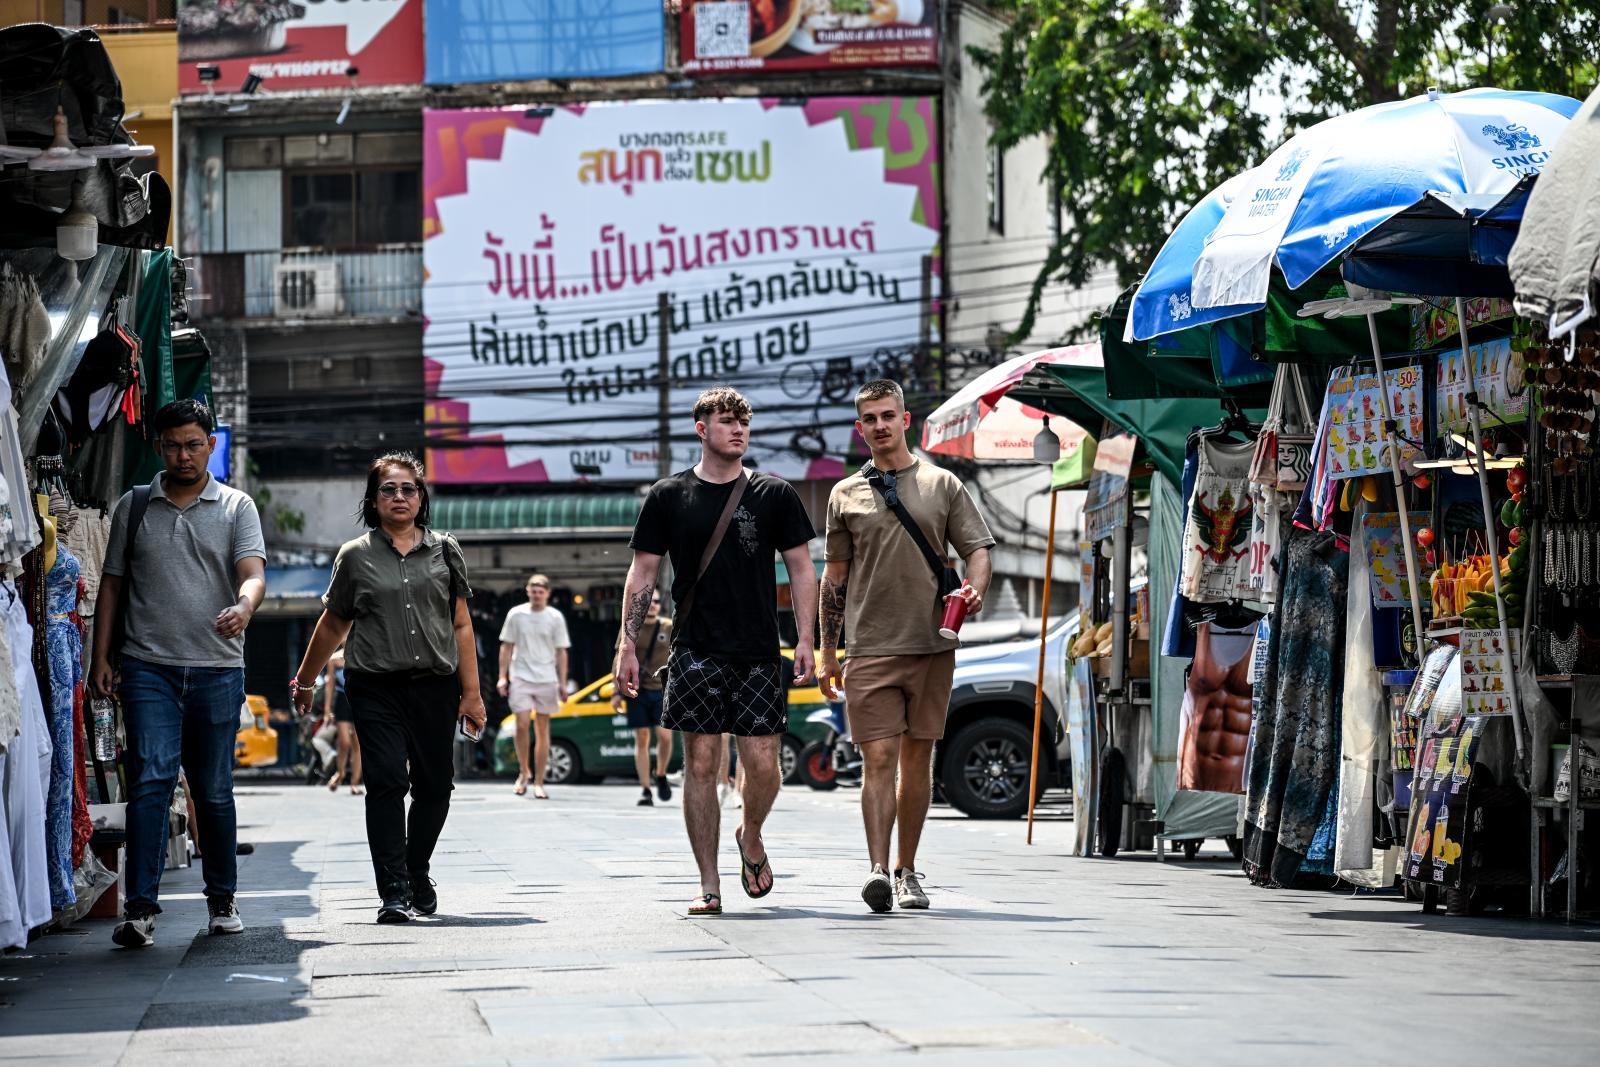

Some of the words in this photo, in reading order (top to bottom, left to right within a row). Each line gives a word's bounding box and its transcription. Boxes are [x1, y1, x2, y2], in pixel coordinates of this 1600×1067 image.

[578, 147, 663, 196] สนุก
[695, 140, 771, 184] เซฟ
[1508, 165, 1545, 180] WA
[1251, 187, 1292, 202] SINGHA
[1248, 203, 1279, 217] WATER
[755, 320, 811, 365] เอย
